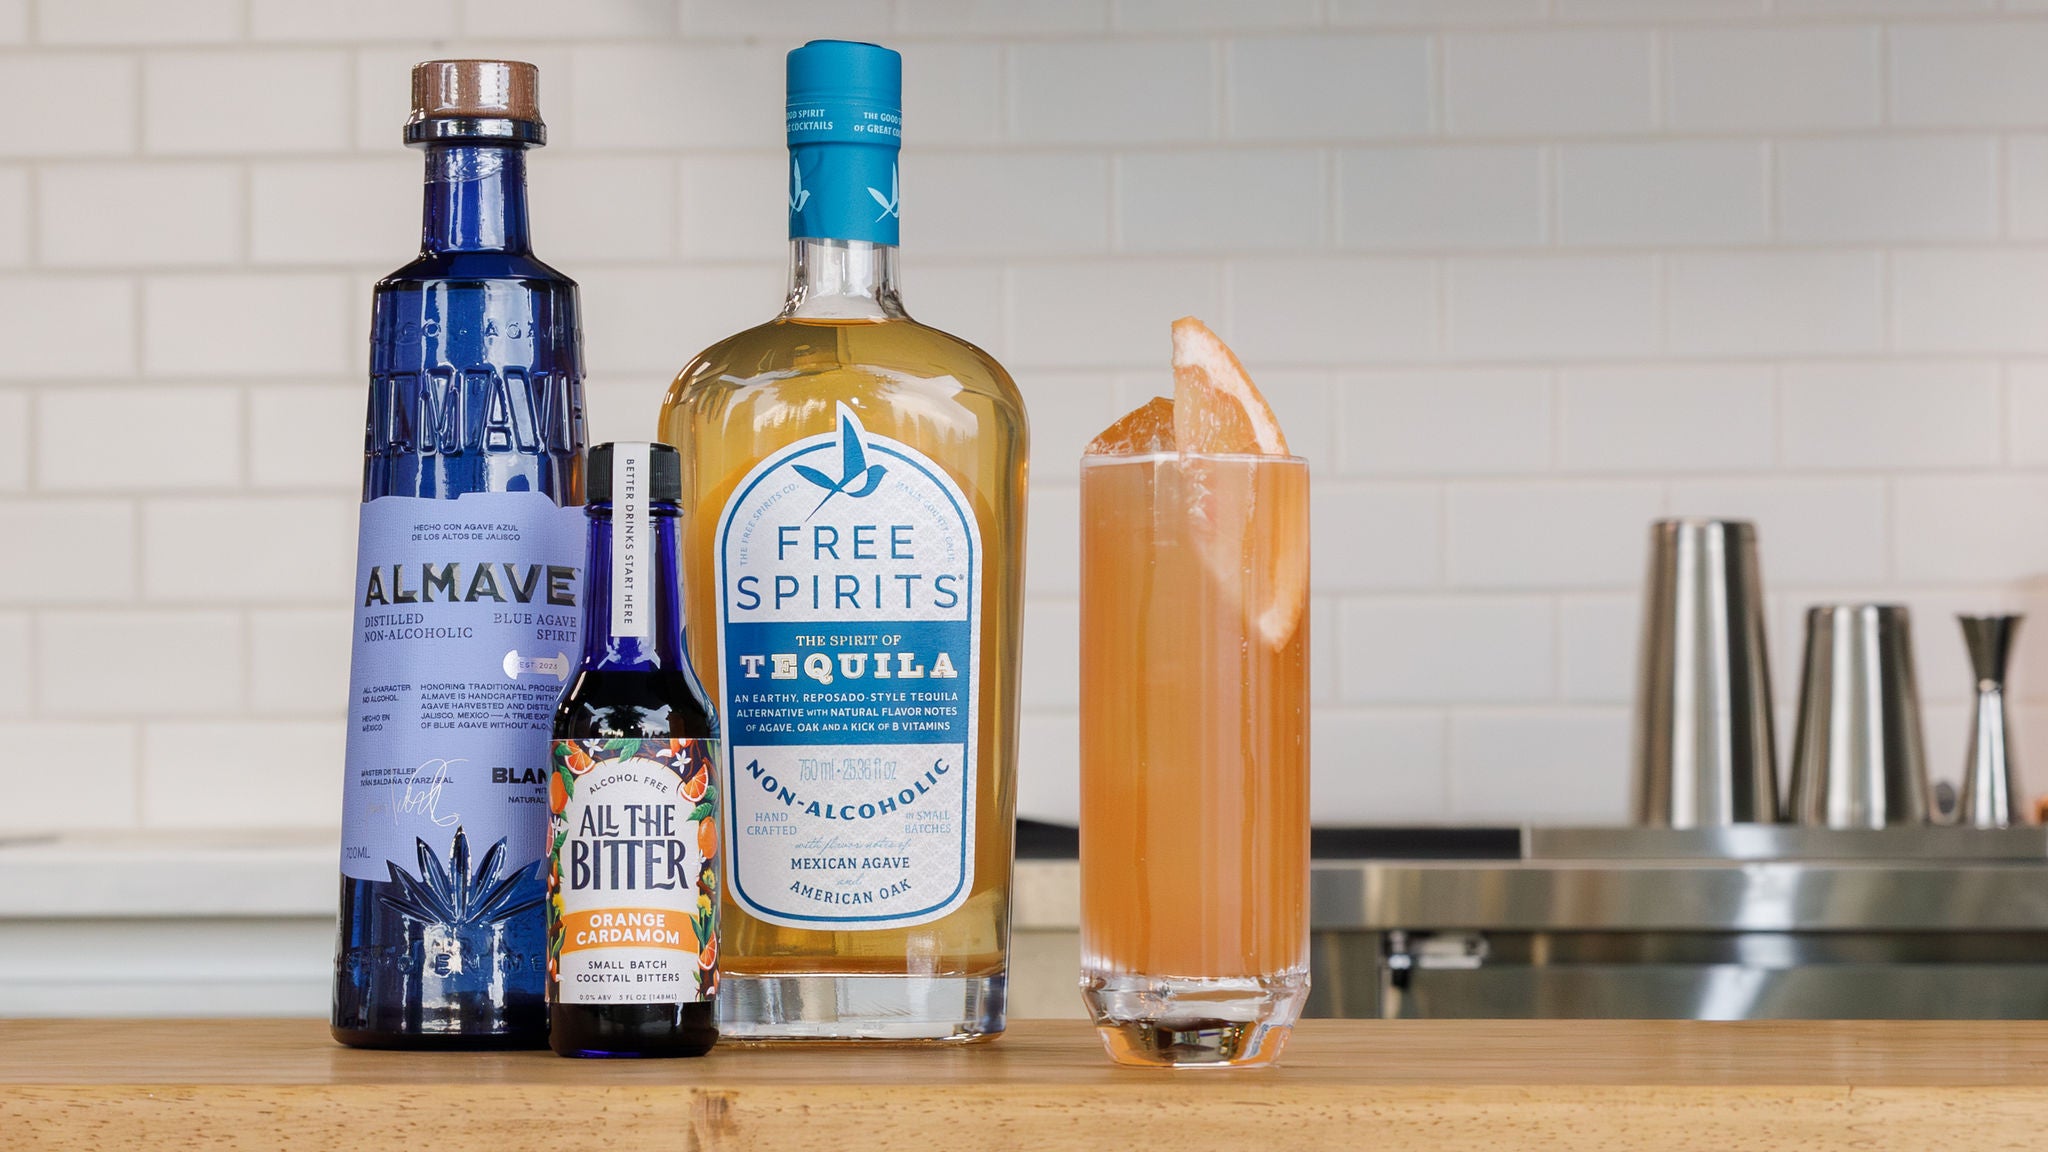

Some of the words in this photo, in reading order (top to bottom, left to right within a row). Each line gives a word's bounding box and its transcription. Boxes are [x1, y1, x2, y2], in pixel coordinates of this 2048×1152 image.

[798, 109, 825, 118] SPIRIT
[863, 111, 878, 120] THE
[791, 121, 834, 132] COCKTAILS
[867, 124, 892, 135] GREAT
[625, 458, 635, 500] BETTER
[753, 490, 783, 521] SPIRITS
[413, 523, 442, 532] HECHO
[443, 523, 462, 531] CON
[463, 523, 494, 531] AGAVE
[496, 523, 519, 532] AZUL
[625, 504, 635, 550] DRINKS
[742, 520, 756, 544] FREE
[411, 533, 423, 542] DE
[423, 533, 441, 541] LOS
[442, 533, 470, 541] ALTOS
[471, 533, 484, 541] DE
[485, 533, 521, 542] JALISCO
[777, 524, 915, 561] FREE
[740, 547, 748, 566] THE
[625, 554, 635, 590] START
[364, 561, 577, 608] ALMAVE
[624, 594, 634, 624] HERE
[364, 613, 424, 628] DISTILLED
[494, 613, 533, 625] BLUE
[537, 614, 577, 628] AGAVE
[364, 627, 473, 643] NON-ALCOHOLIC
[536, 629, 577, 643] SPIRIT
[796, 635, 826, 647] THE
[829, 634, 878, 646] SPIRIT
[881, 634, 902, 646] OF
[739, 652, 959, 686] TEQUILA
[372, 684, 411, 693] CHARACTER
[420, 683, 466, 691] HONORING
[468, 683, 527, 691] TRADITIONAL
[468, 693, 534, 701] HANDCRAFTED
[734, 694, 749, 704] AN
[803, 692, 906, 703] REPOSADO-STYLE
[910, 692, 958, 702] TEQUILA
[451, 702, 505, 710] HARVESTED
[506, 702, 525, 711] AND
[736, 708, 804, 718] ALTERNATIVE
[830, 707, 879, 717] NATURAL
[881, 707, 922, 717] FLAVOR
[924, 706, 958, 716] NOTES
[512, 712, 533, 720] TRUE
[420, 722, 431, 730] OF
[433, 722, 455, 730] BLUE
[457, 721, 489, 730] AGAVE
[490, 722, 529, 730] WITHOUT
[745, 724, 757, 732] OF
[797, 723, 819, 732] OAK
[822, 723, 840, 731] AND
[842, 723, 849, 731] A
[851, 722, 876, 732] KICK
[877, 723, 890, 731] OF
[892, 722, 900, 731] B
[902, 721, 951, 731] VITAMINS
[799, 758, 818, 781] 750
[589, 774, 639, 795] ALCOHOL
[643, 776, 668, 793] FREE
[746, 757, 950, 821] NON-ALCOHOLIC
[579, 804, 620, 838] ALL
[623, 804, 676, 837] THE
[755, 813, 788, 822] HAND
[916, 811, 950, 821] SMALL
[747, 826, 797, 836] CRAFTED
[904, 824, 951, 834] BATCHES
[571, 839, 689, 891] BITTER
[791, 857, 857, 870] MEXICAN
[861, 857, 911, 869] AGAVE
[789, 880, 873, 905] AMERICAN
[879, 878, 912, 900] OAK
[589, 912, 665, 928] ORANGE
[576, 928, 680, 945] CARDAMOM
[588, 960, 625, 969] SMALL
[630, 960, 667, 969] BATCH
[576, 974, 631, 983] COCKTAIL
[636, 973, 680, 982] BITTERS
